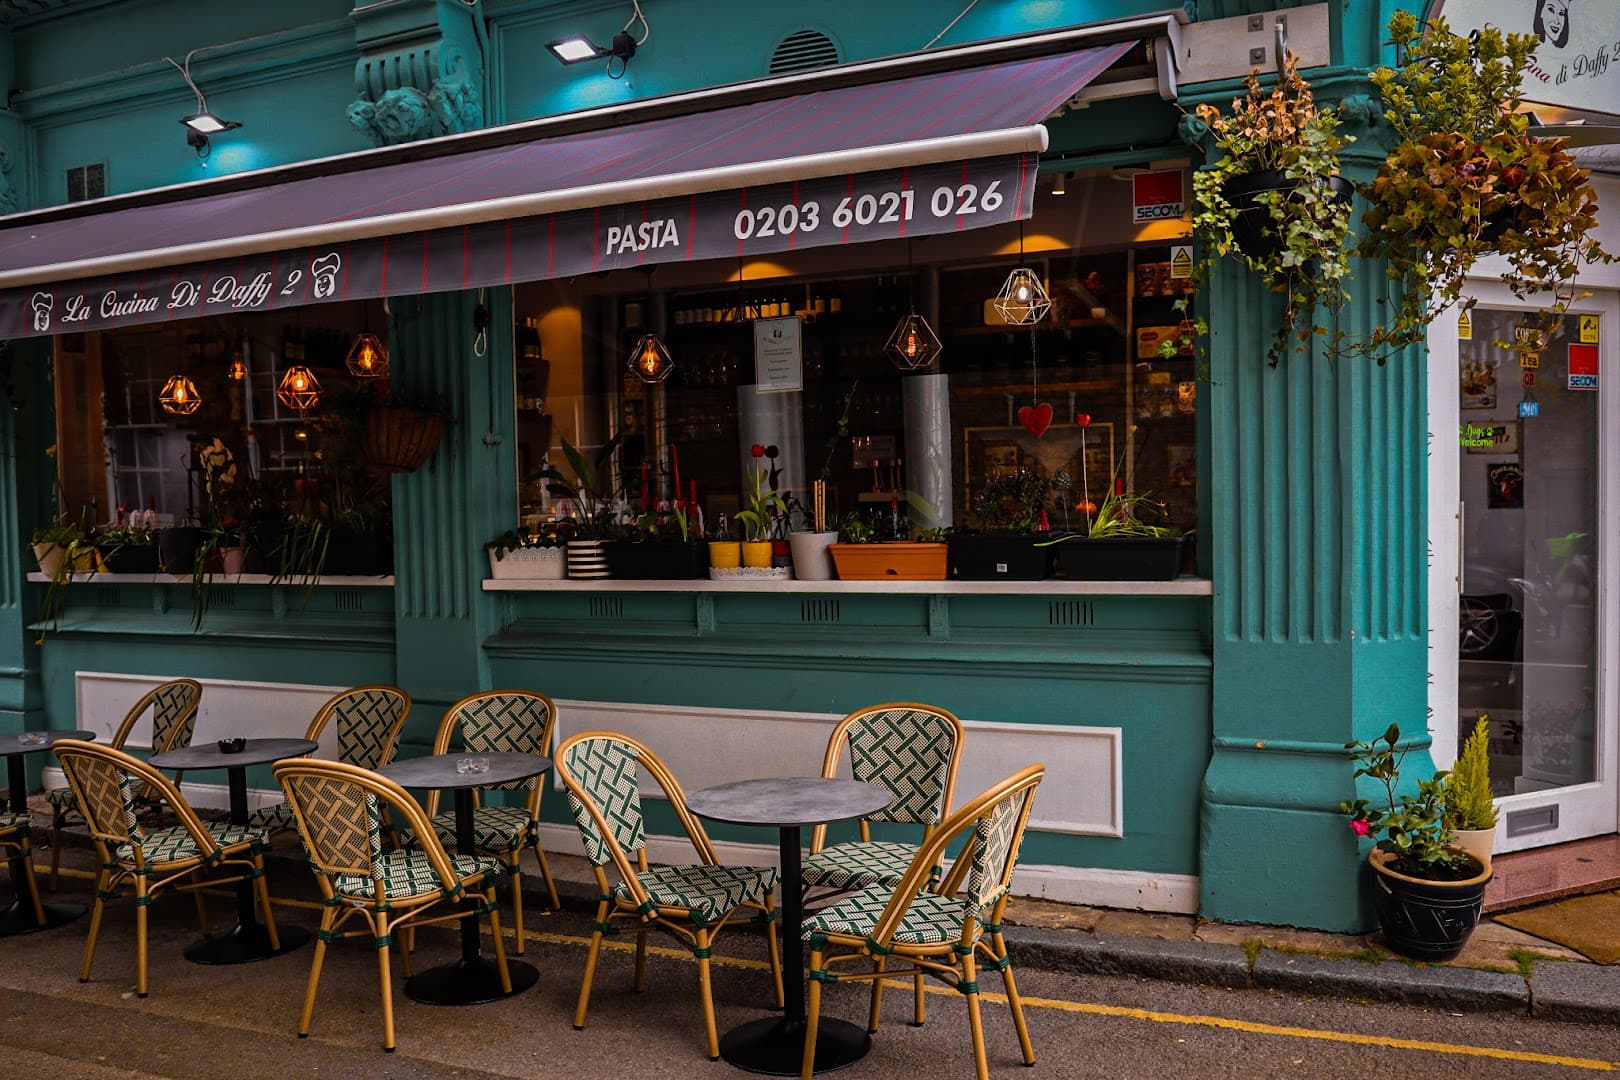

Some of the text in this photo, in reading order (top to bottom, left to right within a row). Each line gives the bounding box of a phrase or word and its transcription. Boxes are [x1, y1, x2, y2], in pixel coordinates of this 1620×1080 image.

[1555, 63, 1568, 85] di
[1573, 45, 1608, 78] Daffy
[734, 180, 1004, 240] 0203 6021 026
[1137, 204, 1182, 218] SECOM
[606, 218, 680, 255] PASTA
[61, 270, 302, 322] La Cucina Di Daffy 2
[1521, 352, 1537, 366] Tea
[1570, 376, 1597, 386] SECOM
